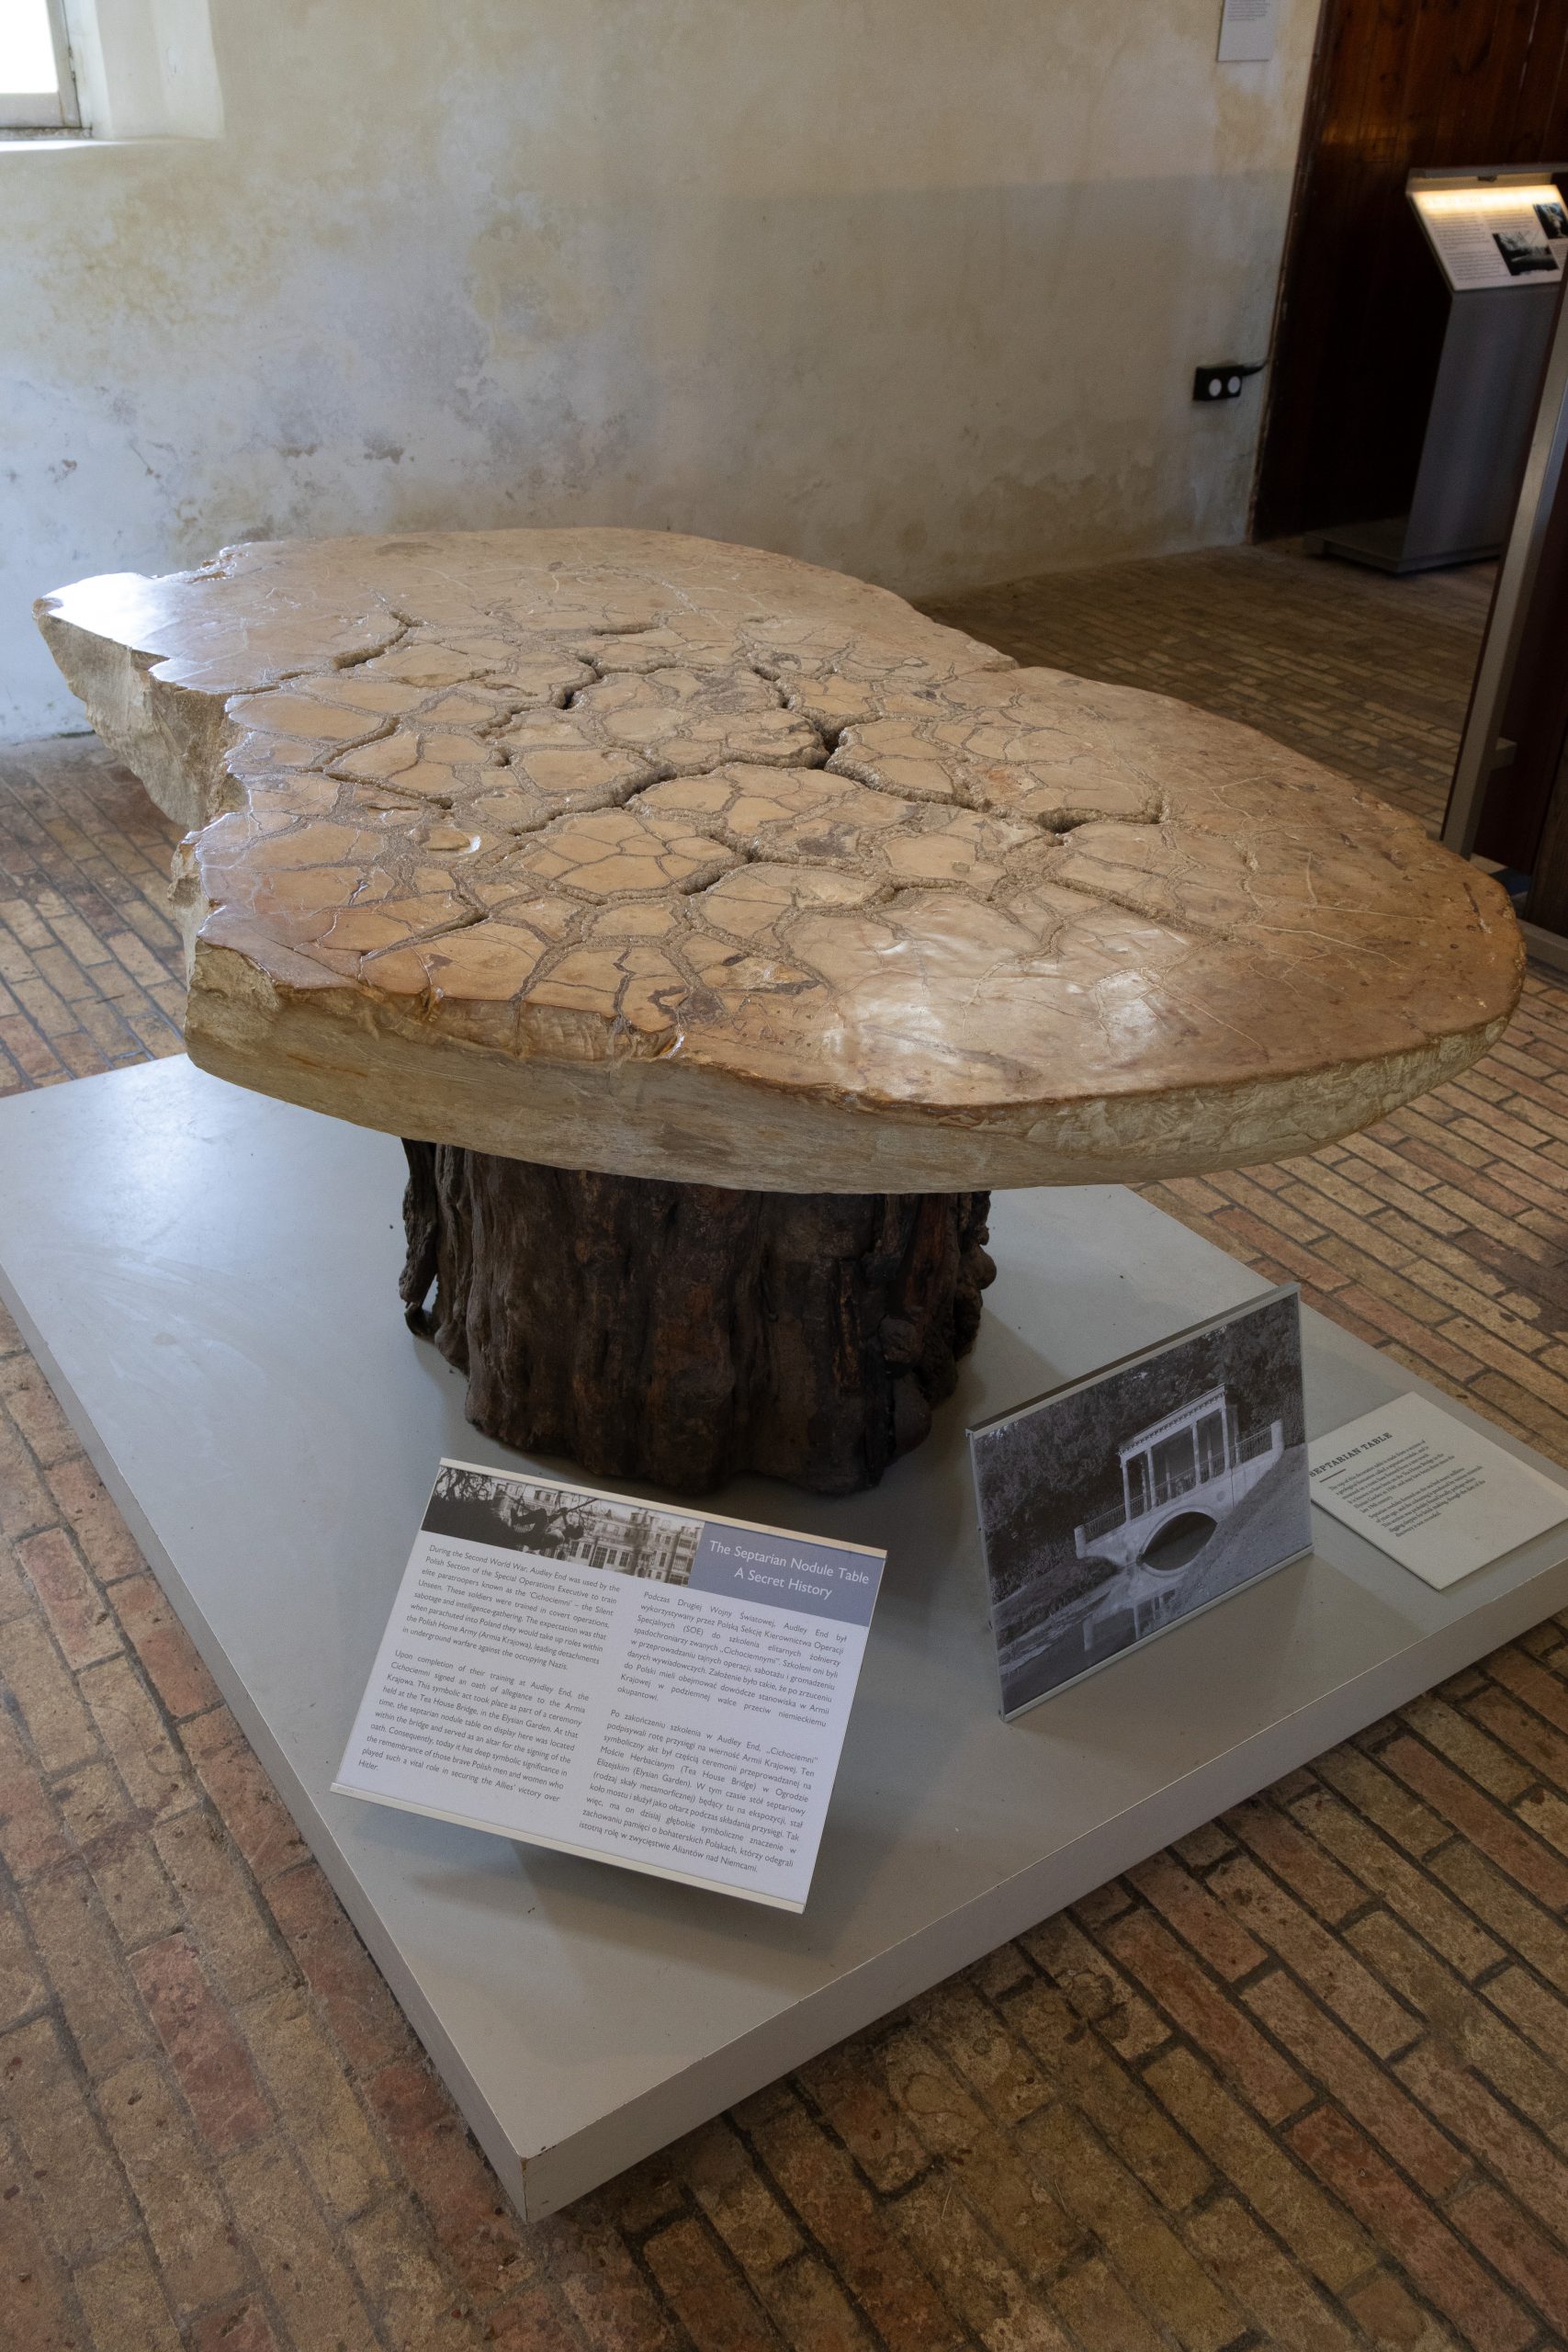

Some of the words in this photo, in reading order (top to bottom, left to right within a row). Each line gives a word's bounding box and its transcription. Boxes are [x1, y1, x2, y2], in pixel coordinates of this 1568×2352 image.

[1309, 1447, 1363, 1477] SEPTARIAN
[1359, 1431, 1393, 1452] TABLE
[425, 1555, 445, 1566] Polish
[446, 1560, 470, 1572] Section
[481, 1568, 492, 1577] the
[494, 1571, 517, 1582] Special
[518, 1577, 555, 1591] Operations
[558, 1585, 589, 1599] Executive
[601, 1596, 617, 1604] train
[429, 1544, 451, 1557] During
[452, 1550, 463, 1558] the
[464, 1552, 489, 1564] Second
[490, 1557, 512, 1568] World
[513, 1563, 528, 1573] War,
[529, 1566, 553, 1579] Audley
[554, 1571, 568, 1581] End
[582, 1579, 599, 1588] used
[599, 1582, 607, 1591] by
[609, 1584, 621, 1593] the
[710, 1540, 731, 1555] The
[734, 1545, 786, 1566] Septarian
[790, 1557, 834, 1577] Nodule
[838, 1567, 869, 1584] Table
[734, 1566, 744, 1579] A
[748, 1569, 784, 1588] Secret
[788, 1577, 832, 1600] History
[413, 1592, 442, 1604] sabotage
[456, 1601, 524, 1623] intelligence-gathering.
[526, 1615, 538, 1625] The
[539, 1621, 578, 1634] expectation
[592, 1632, 606, 1641] that
[418, 1578, 443, 1590] Unseen.
[446, 1585, 466, 1596] These
[468, 1591, 493, 1602] soldiers
[495, 1598, 512, 1606] were
[514, 1602, 538, 1612] trained
[548, 1610, 570, 1620] covert
[572, 1615, 609, 1629] operations,
[422, 1568, 435, 1577] elite
[437, 1573, 479, 1587] paratroopers
[481, 1580, 503, 1591] known
[514, 1589, 526, 1597] the
[581, 1603, 592, 1611] the
[594, 1606, 615, 1616] Silent
[643, 1590, 671, 1603] Podczas
[677, 1599, 703, 1612] Drugiej
[710, 1605, 733, 1619] Wojny
[783, 1623, 807, 1635] Audley
[815, 1629, 829, 1638] End
[402, 1625, 409, 1634] in
[410, 1630, 452, 1644] underground
[453, 1639, 478, 1649] warfare
[478, 1645, 501, 1655] against
[502, 1649, 513, 1657] the
[514, 1653, 547, 1668] occupying
[548, 1659, 568, 1670] Nazis.
[406, 1614, 417, 1623] the
[418, 1616, 437, 1627] Polish
[437, 1621, 458, 1632] Home
[458, 1626, 478, 1638] Army
[478, 1631, 501, 1642] (Armia
[502, 1635, 533, 1650] Krajowa),
[534, 1643, 558, 1657] leading
[558, 1649, 600, 1665] detachments
[410, 1603, 428, 1612] when
[428, 1608, 465, 1621] parachuted
[465, 1614, 479, 1623] into
[479, 1618, 502, 1629] Poland
[502, 1623, 517, 1634] they
[518, 1628, 539, 1637] would
[539, 1633, 554, 1641] take
[564, 1639, 581, 1647] roles
[582, 1643, 604, 1652] within
[637, 1614, 675, 1629] Specjalnych
[728, 1636, 760, 1648] szkolenia
[767, 1645, 802, 1657] elitarnych
[390, 1661, 431, 1677] Cichociemni
[434, 1673, 456, 1683] signed
[470, 1682, 486, 1690] oath
[501, 1688, 533, 1702] allegiance
[549, 1699, 560, 1708] the
[564, 1702, 586, 1713] Armia
[395, 1649, 413, 1660] Upon
[417, 1657, 454, 1669] completion
[469, 1668, 486, 1677] their
[490, 1673, 515, 1686] training
[530, 1681, 554, 1694] Audley
[558, 1687, 572, 1698] End,
[578, 1691, 590, 1702] the
[620, 1673, 651, 1689] Krajowej
[671, 1686, 711, 1702] podziemnej
[717, 1697, 737, 1707] walce
[743, 1703, 772, 1714] przeciw
[778, 1712, 827, 1727] niemieckiemu
[610, 1709, 620, 1718] Po
[670, 1724, 702, 1737] szkolenia
[716, 1735, 742, 1748] Audley
[358, 1759, 379, 1770] Hitler.
[361, 1747, 384, 1758] played
[386, 1754, 401, 1762] such
[410, 1759, 424, 1769] vital
[425, 1764, 440, 1772] role
[442, 1767, 449, 1775] in
[451, 1770, 479, 1784] securing
[481, 1777, 493, 1786] the
[518, 1787, 542, 1800] victory
[544, 1793, 560, 1802] over
[630, 1752, 675, 1770] Herbacianym
[702, 1770, 726, 1782] House
[775, 1788, 809, 1803] Ogrodzie
[705, 1854, 719, 1862] nad
